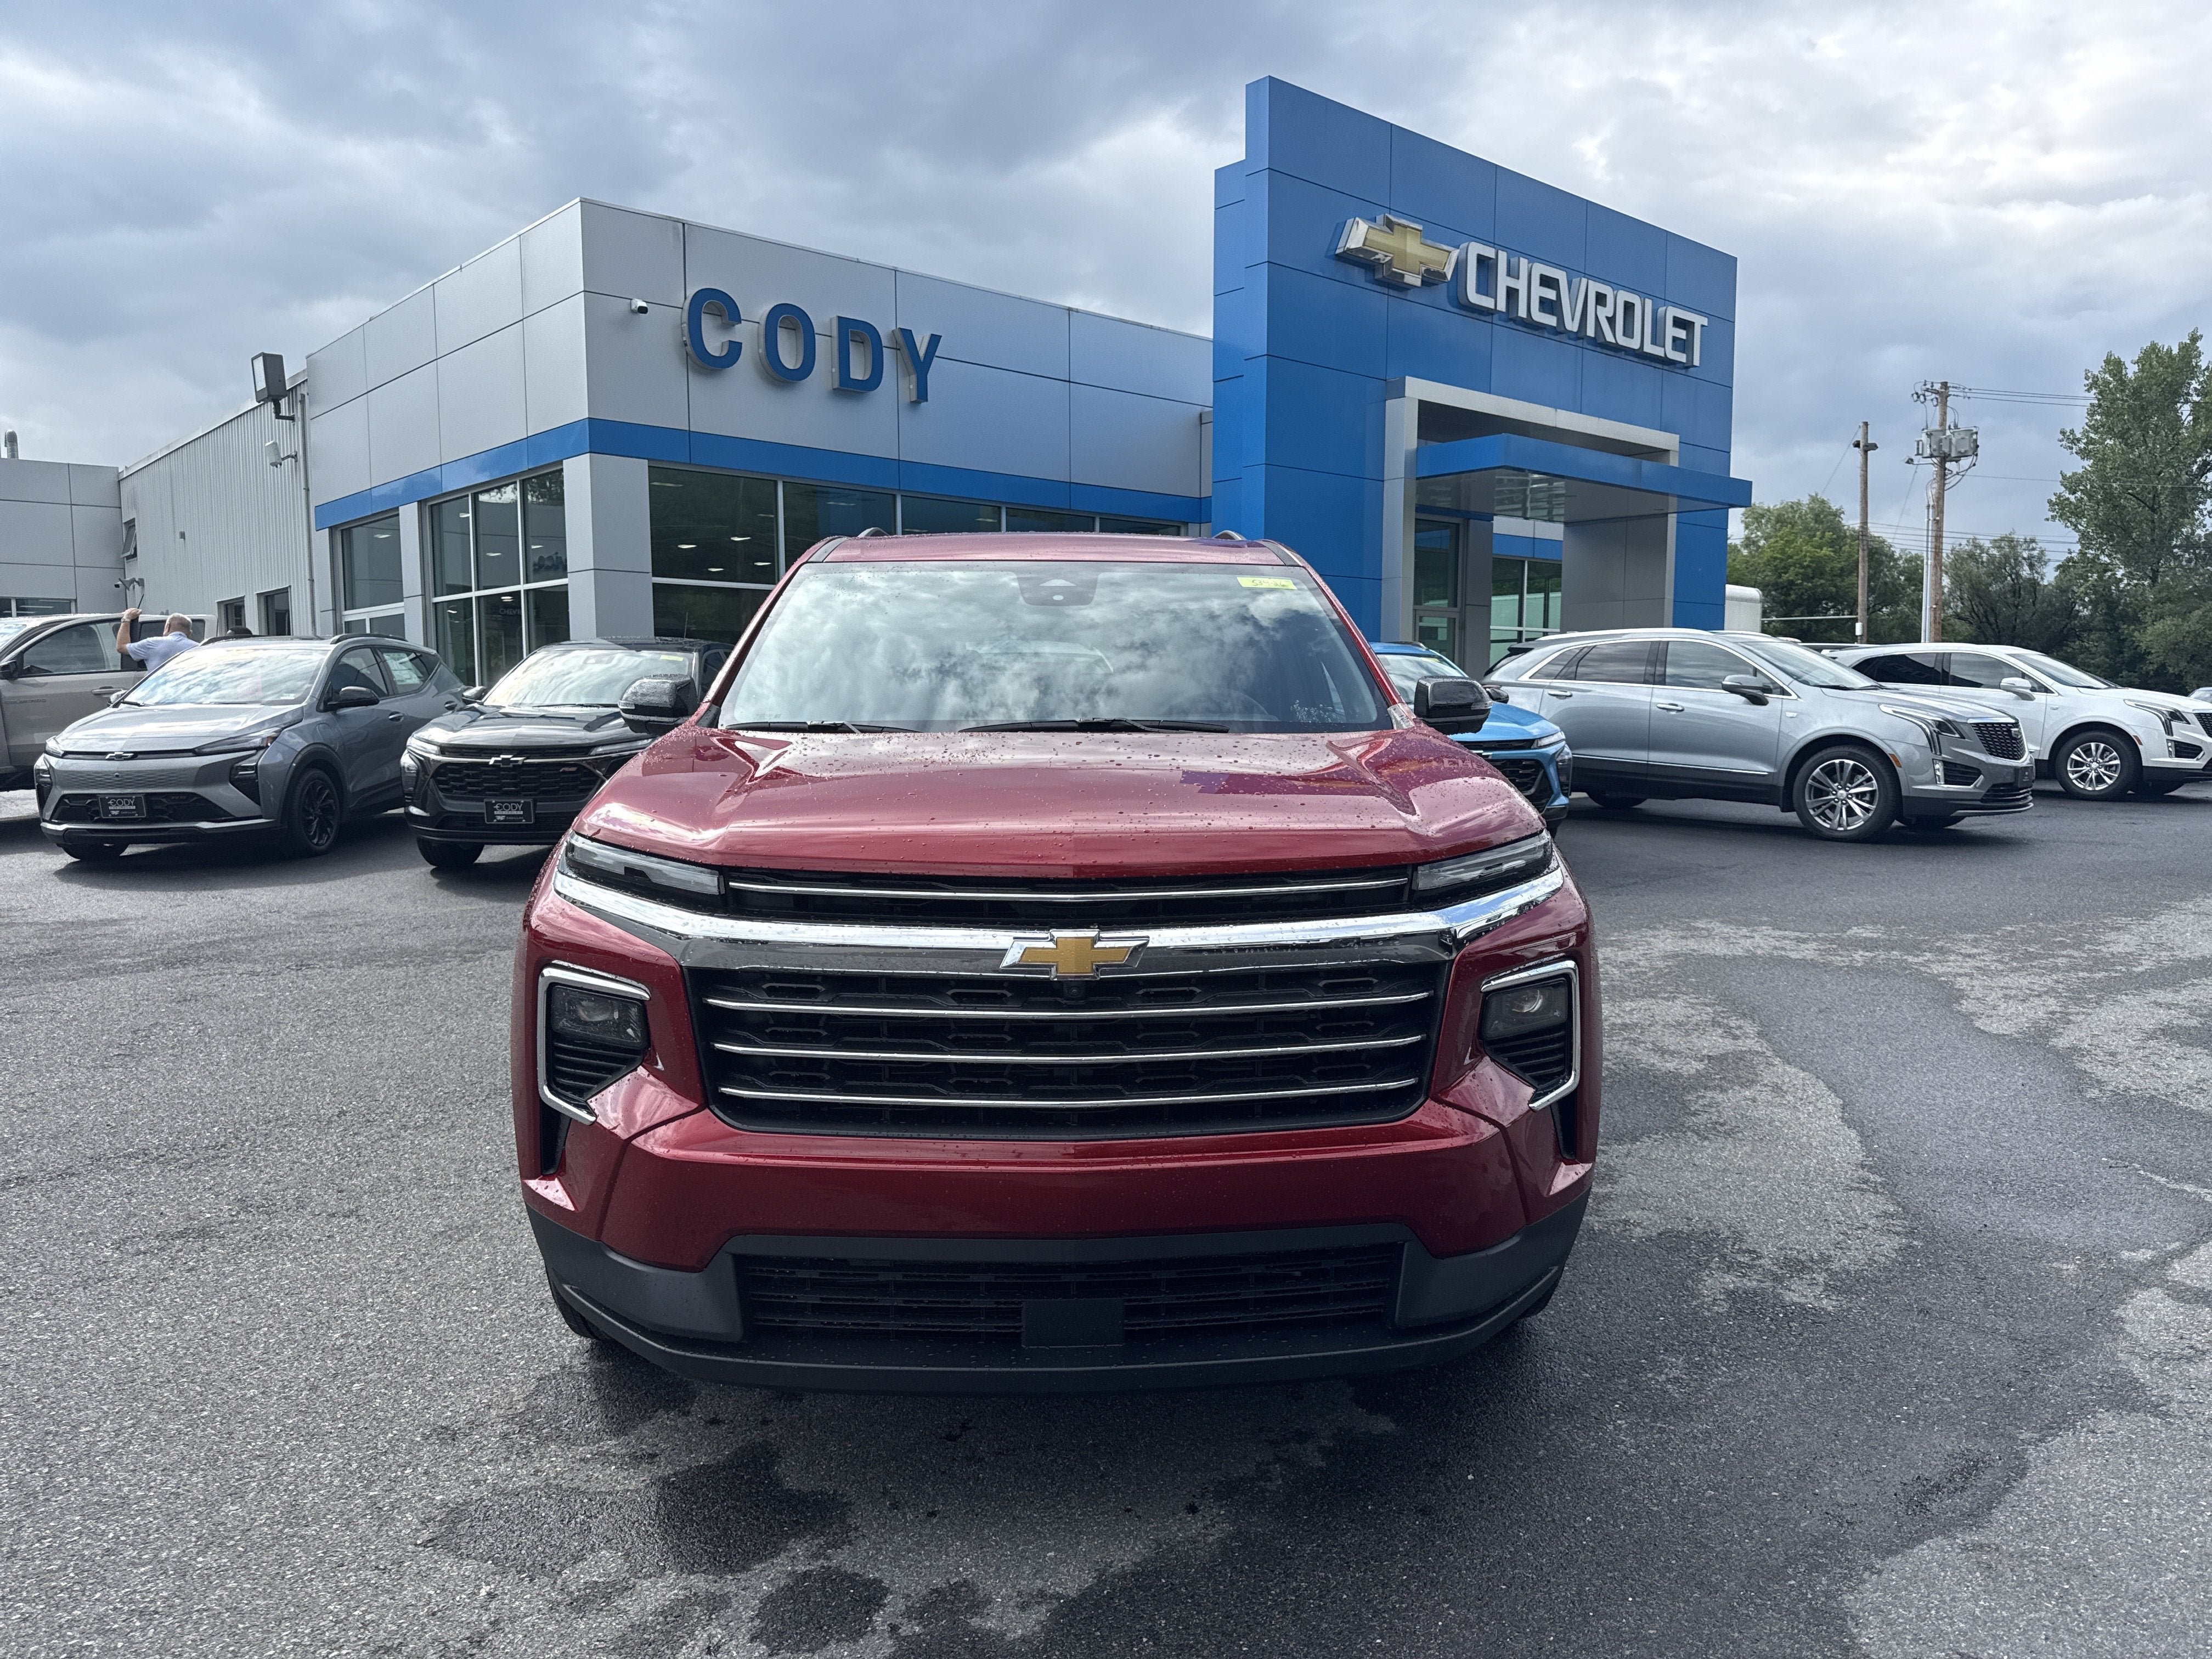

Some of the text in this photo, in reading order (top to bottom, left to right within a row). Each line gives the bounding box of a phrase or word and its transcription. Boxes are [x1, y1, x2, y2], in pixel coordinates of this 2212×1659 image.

[682, 287, 943, 404] CODY
[1458, 241, 1708, 369] CHEVROLET
[108, 798, 135, 806] CODY
